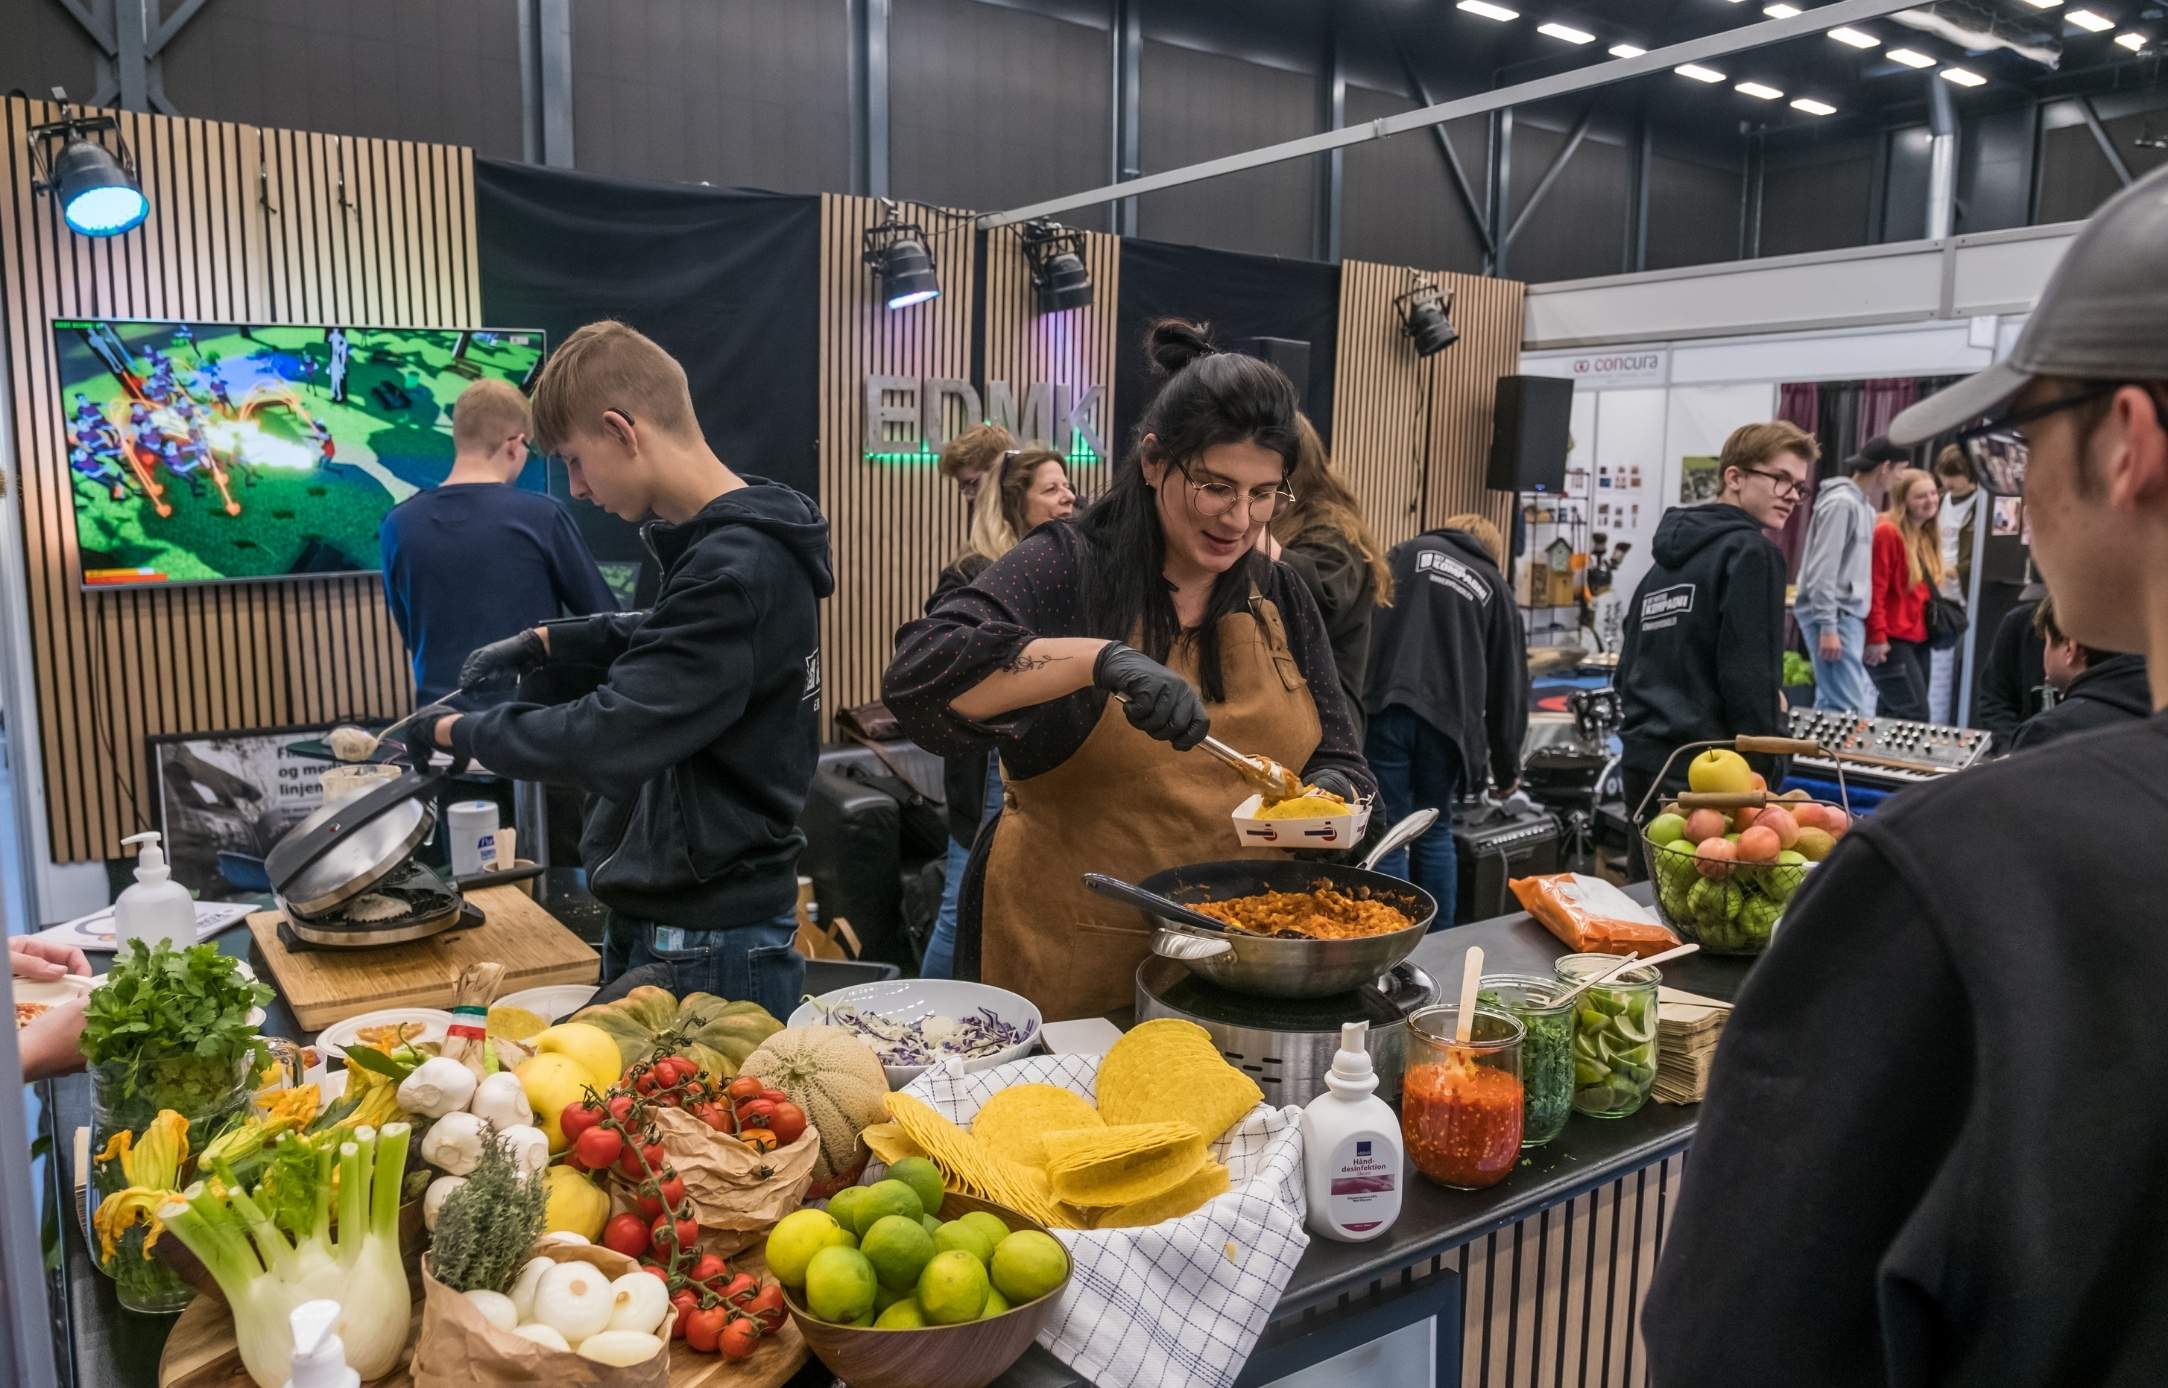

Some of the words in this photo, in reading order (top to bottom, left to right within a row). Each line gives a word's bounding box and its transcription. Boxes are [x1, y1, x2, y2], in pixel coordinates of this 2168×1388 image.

[1594, 355, 1659, 372] concura
[865, 374, 1106, 457] EDMK
[278, 767, 298, 780] og
[280, 783, 324, 798] linjen
